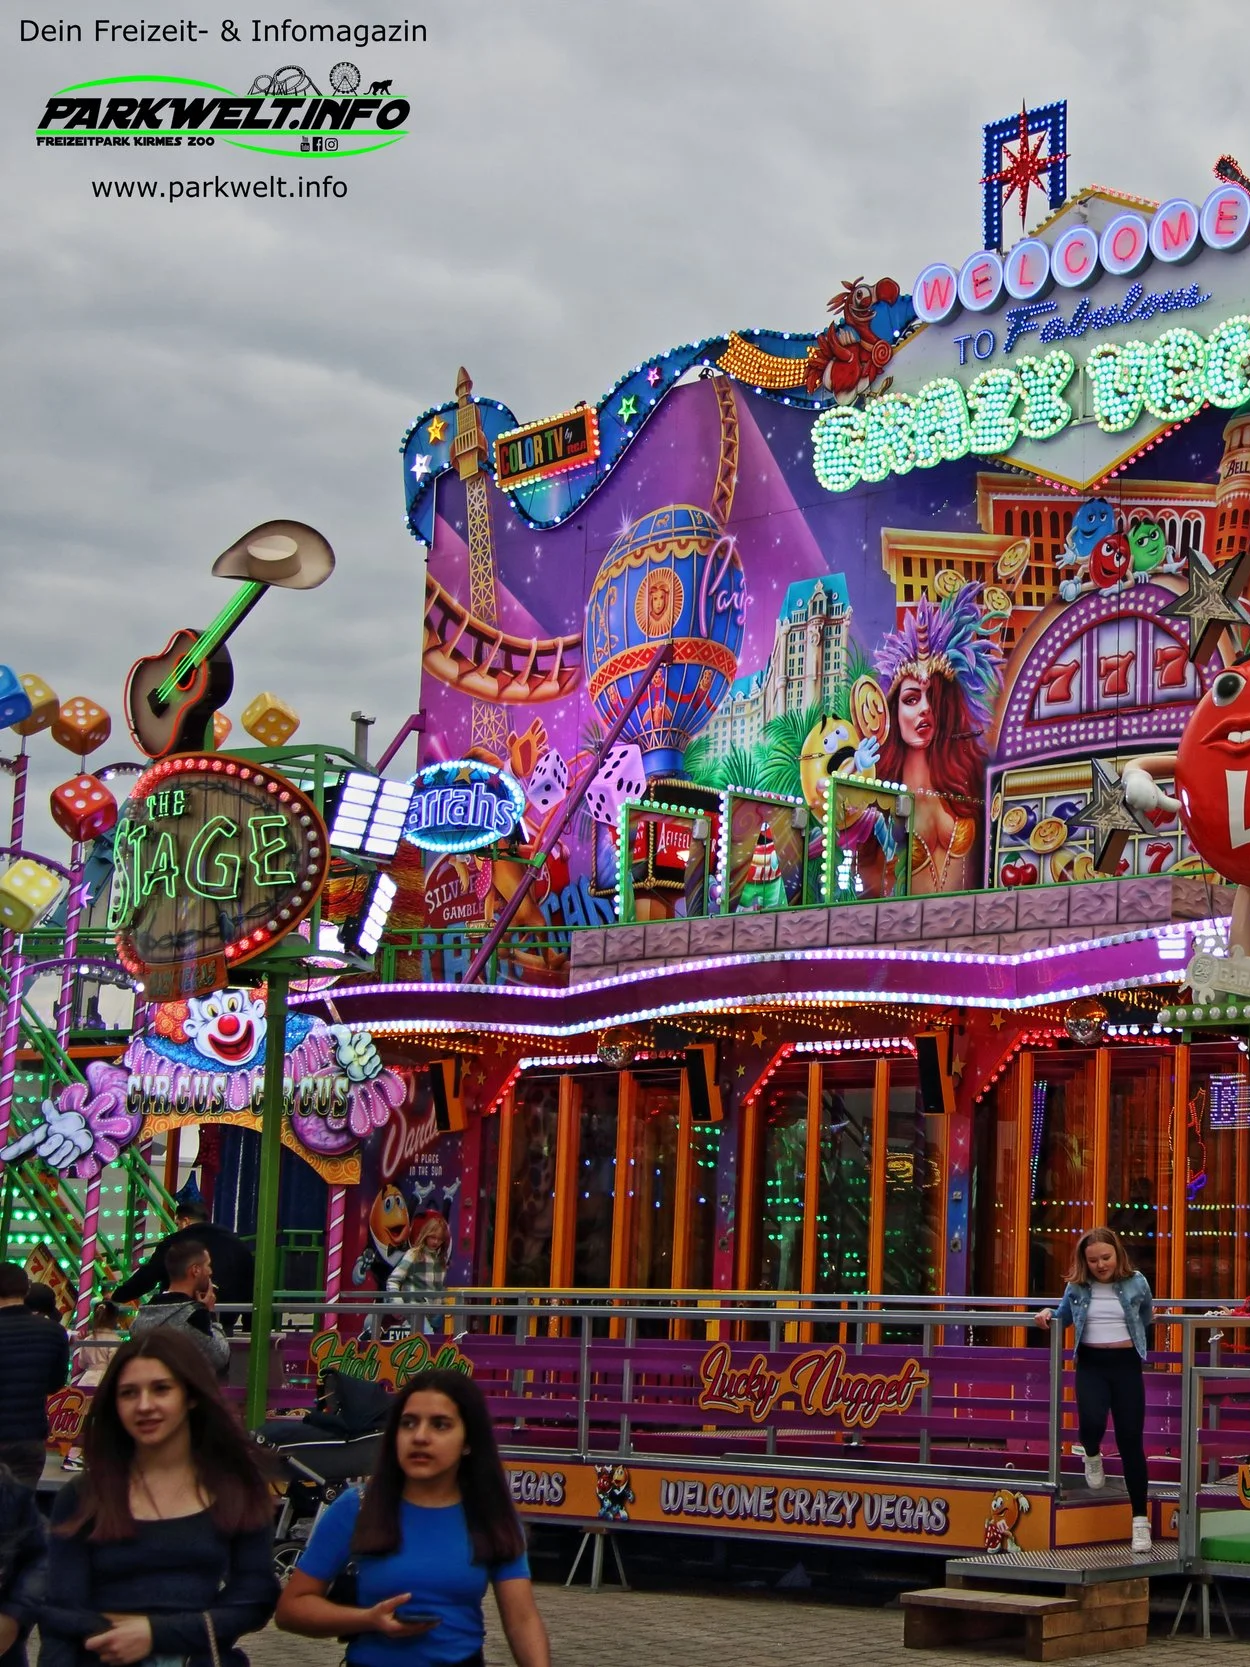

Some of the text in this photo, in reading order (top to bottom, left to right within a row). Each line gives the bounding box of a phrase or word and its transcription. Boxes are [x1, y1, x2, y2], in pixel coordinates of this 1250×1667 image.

[922, 199, 1240, 311] WELCOME
[953, 282, 1212, 366] TO Fabulous
[811, 349, 1075, 493] CRAZY
[501, 426, 573, 475] COLOR TV by
[701, 535, 754, 638] Paris
[146, 790, 186, 820] THE
[404, 783, 514, 836] arrahs
[107, 814, 296, 931] STAGE
[125, 1075, 350, 1117] CIRCUS CRCUS
[418, 1166, 429, 1176] THE
[431, 1166, 443, 1176] SUN
[421, 1153, 439, 1164] PLACE
[701, 1344, 927, 1427] Lucky Nugget
[660, 1479, 777, 1524] WELCOME
[777, 1485, 861, 1528] CRAZY
[862, 1492, 949, 1535] VEGAS
